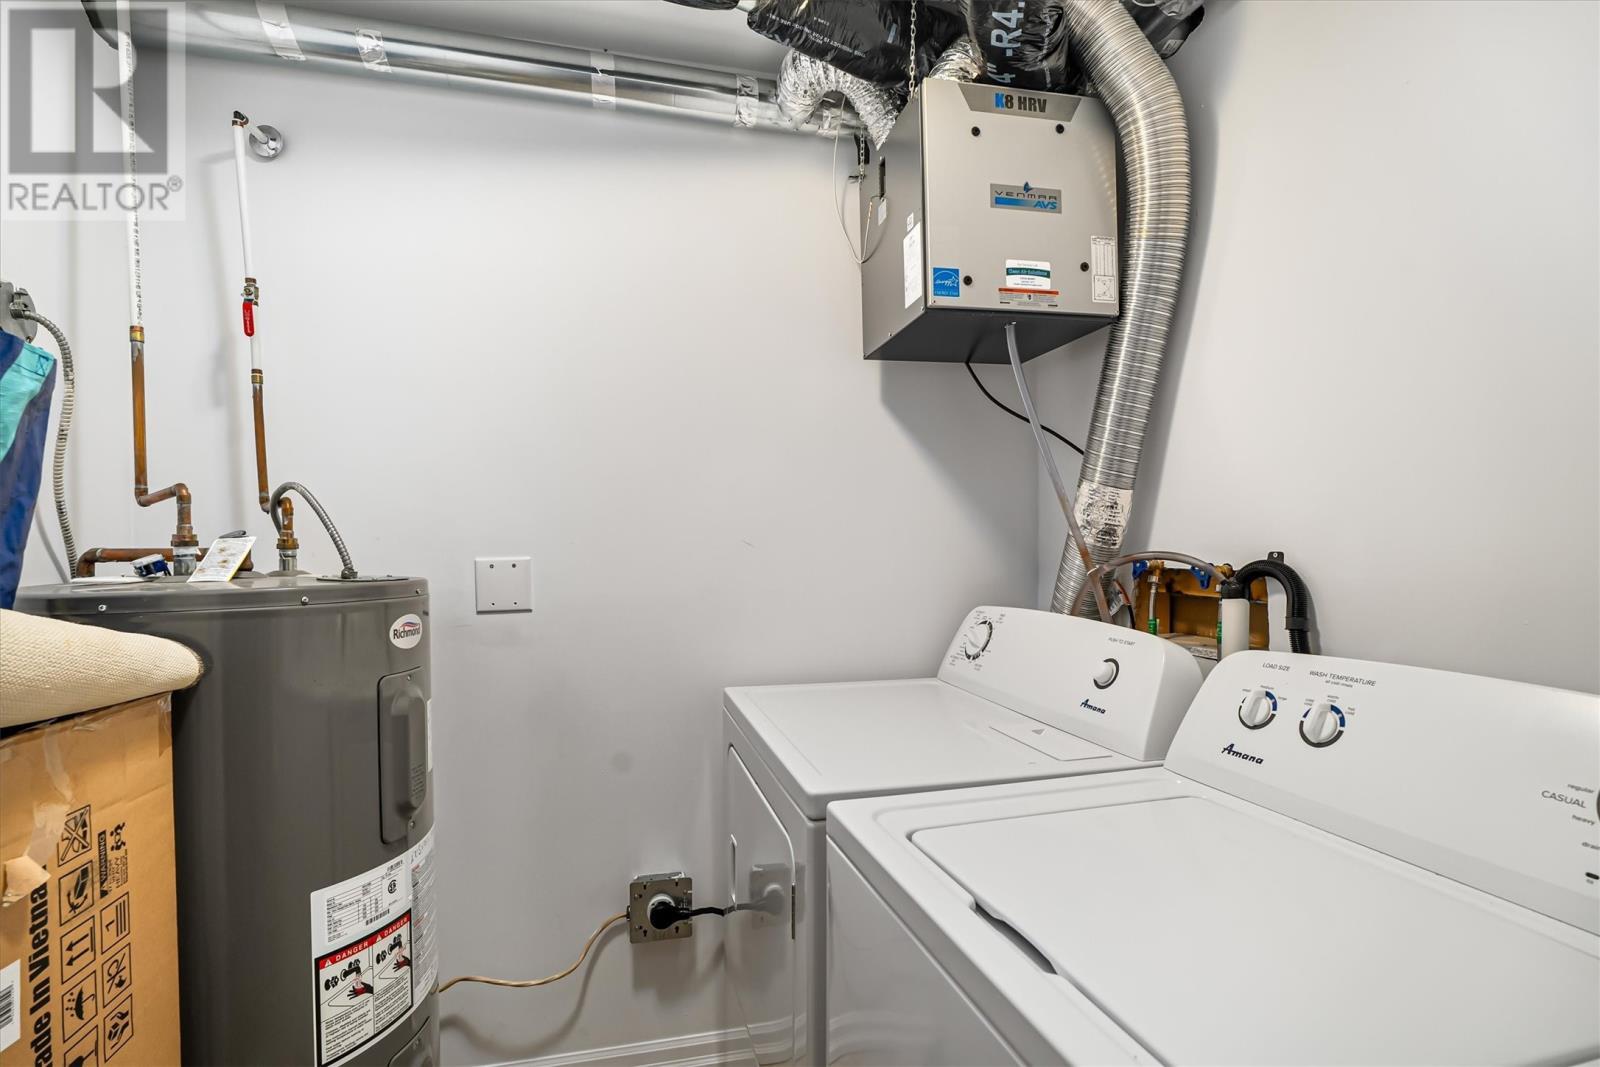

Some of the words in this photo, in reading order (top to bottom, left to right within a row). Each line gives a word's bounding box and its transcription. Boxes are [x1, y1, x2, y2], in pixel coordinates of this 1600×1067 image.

[995, 92, 1014, 109] K8
[1017, 96, 1047, 113] HRV
[1033, 200, 1058, 210] AVS
[393, 623, 421, 639] Richmond
[1262, 662, 1278, 670] LOAD
[1309, 670, 1328, 678] WASH
[1328, 673, 1377, 687] TEMPERATURE
[1080, 698, 1107, 714] Amana
[1221, 743, 1264, 765] Amana
[1541, 790, 1587, 809] CASUAL
[99, 833, 107, 882] WARNING
[28, 865, 52, 983] Vietna
[384, 916, 408, 937] DANGER
[335, 940, 369, 961] DANGER
[29, 976, 51, 1017] In
[29, 1010, 53, 1067] ade
